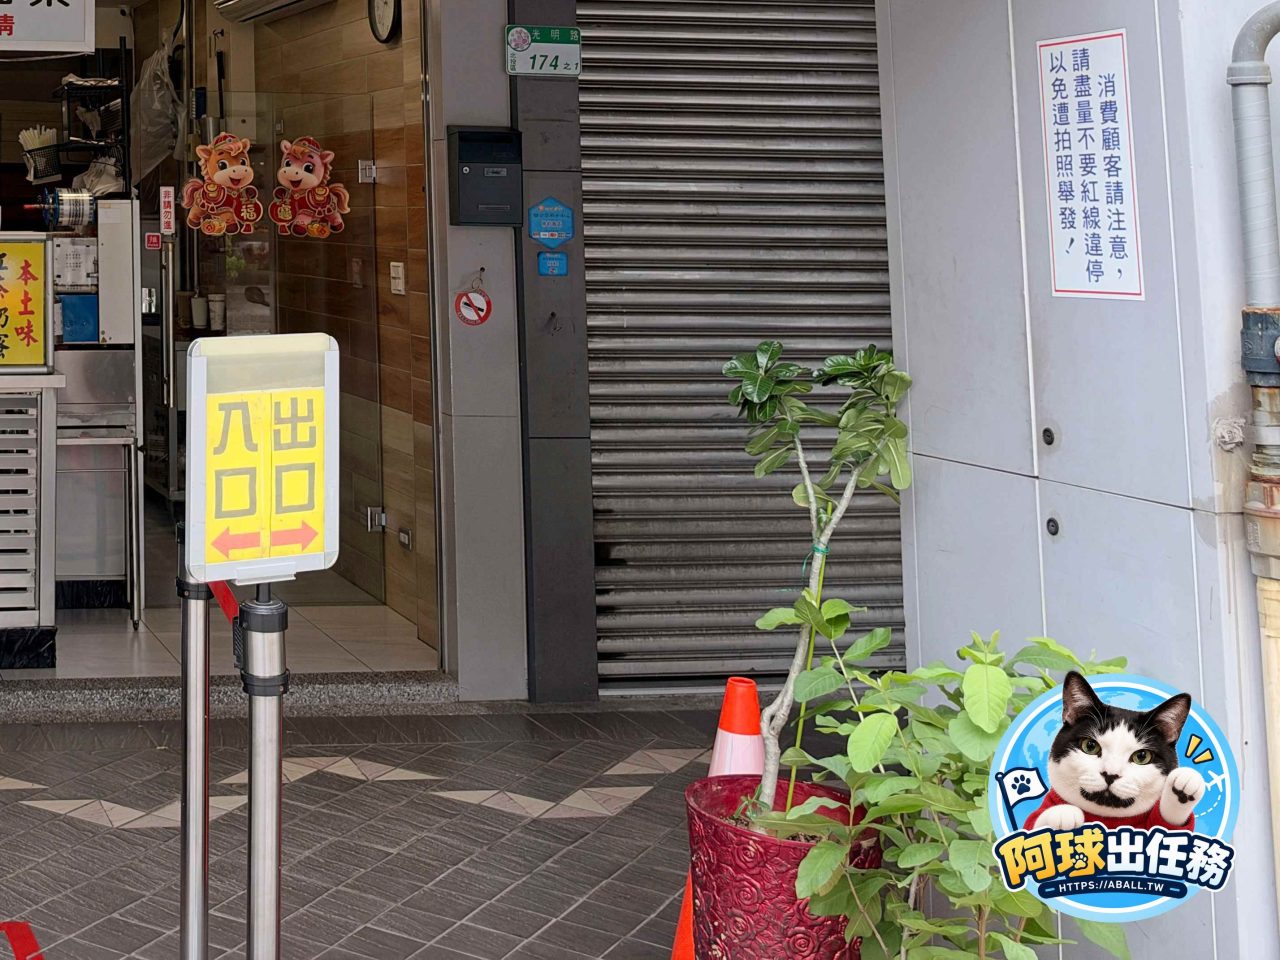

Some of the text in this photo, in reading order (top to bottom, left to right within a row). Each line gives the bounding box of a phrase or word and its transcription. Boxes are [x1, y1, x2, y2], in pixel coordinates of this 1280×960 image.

[532, 29, 578, 40] 光明路
[1072, 47, 1105, 284] 請盡量不要紅線違停
[14, 259, 39, 347] 本土味
[213, 401, 258, 519] 入口
[273, 397, 317, 515] 出口
